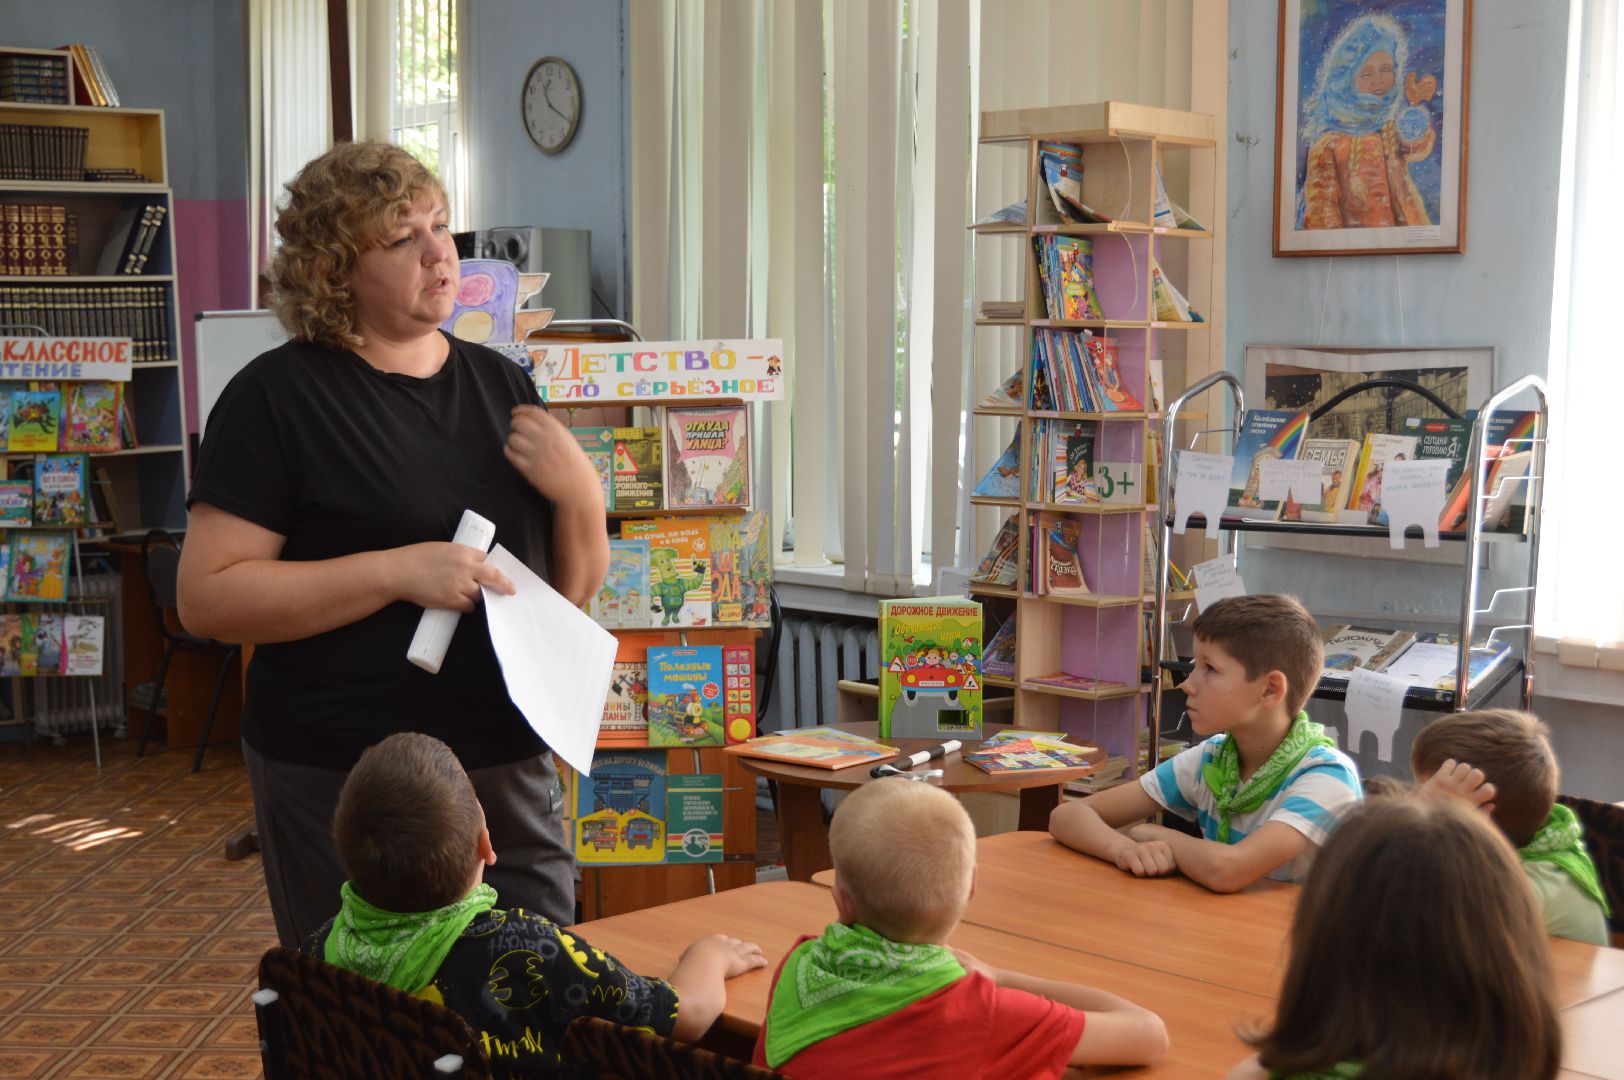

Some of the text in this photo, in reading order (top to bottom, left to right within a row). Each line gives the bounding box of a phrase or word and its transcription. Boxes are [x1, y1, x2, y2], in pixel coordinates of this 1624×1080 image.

[0, 362, 82, 377] ТЕНИЕ
[551, 347, 737, 382] ДЕТСТВО
[685, 420, 730, 432] ОТКУДА
[686, 431, 726, 440] ПРИШЛА
[1423, 436, 1448, 446] СЕГОДНЯ
[685, 438, 729, 451] УЛИЦА?
[1422, 445, 1447, 454] ГОТОВЛЮ
[1303, 448, 1346, 467] СЕМЬЯ
[1098, 466, 1134, 498] 3+
[616, 489, 654, 497] ДВИЖЕНИЯ
[890, 605, 978, 617] ДОРОЖНОЕ ДВИЖЕНИЕ
